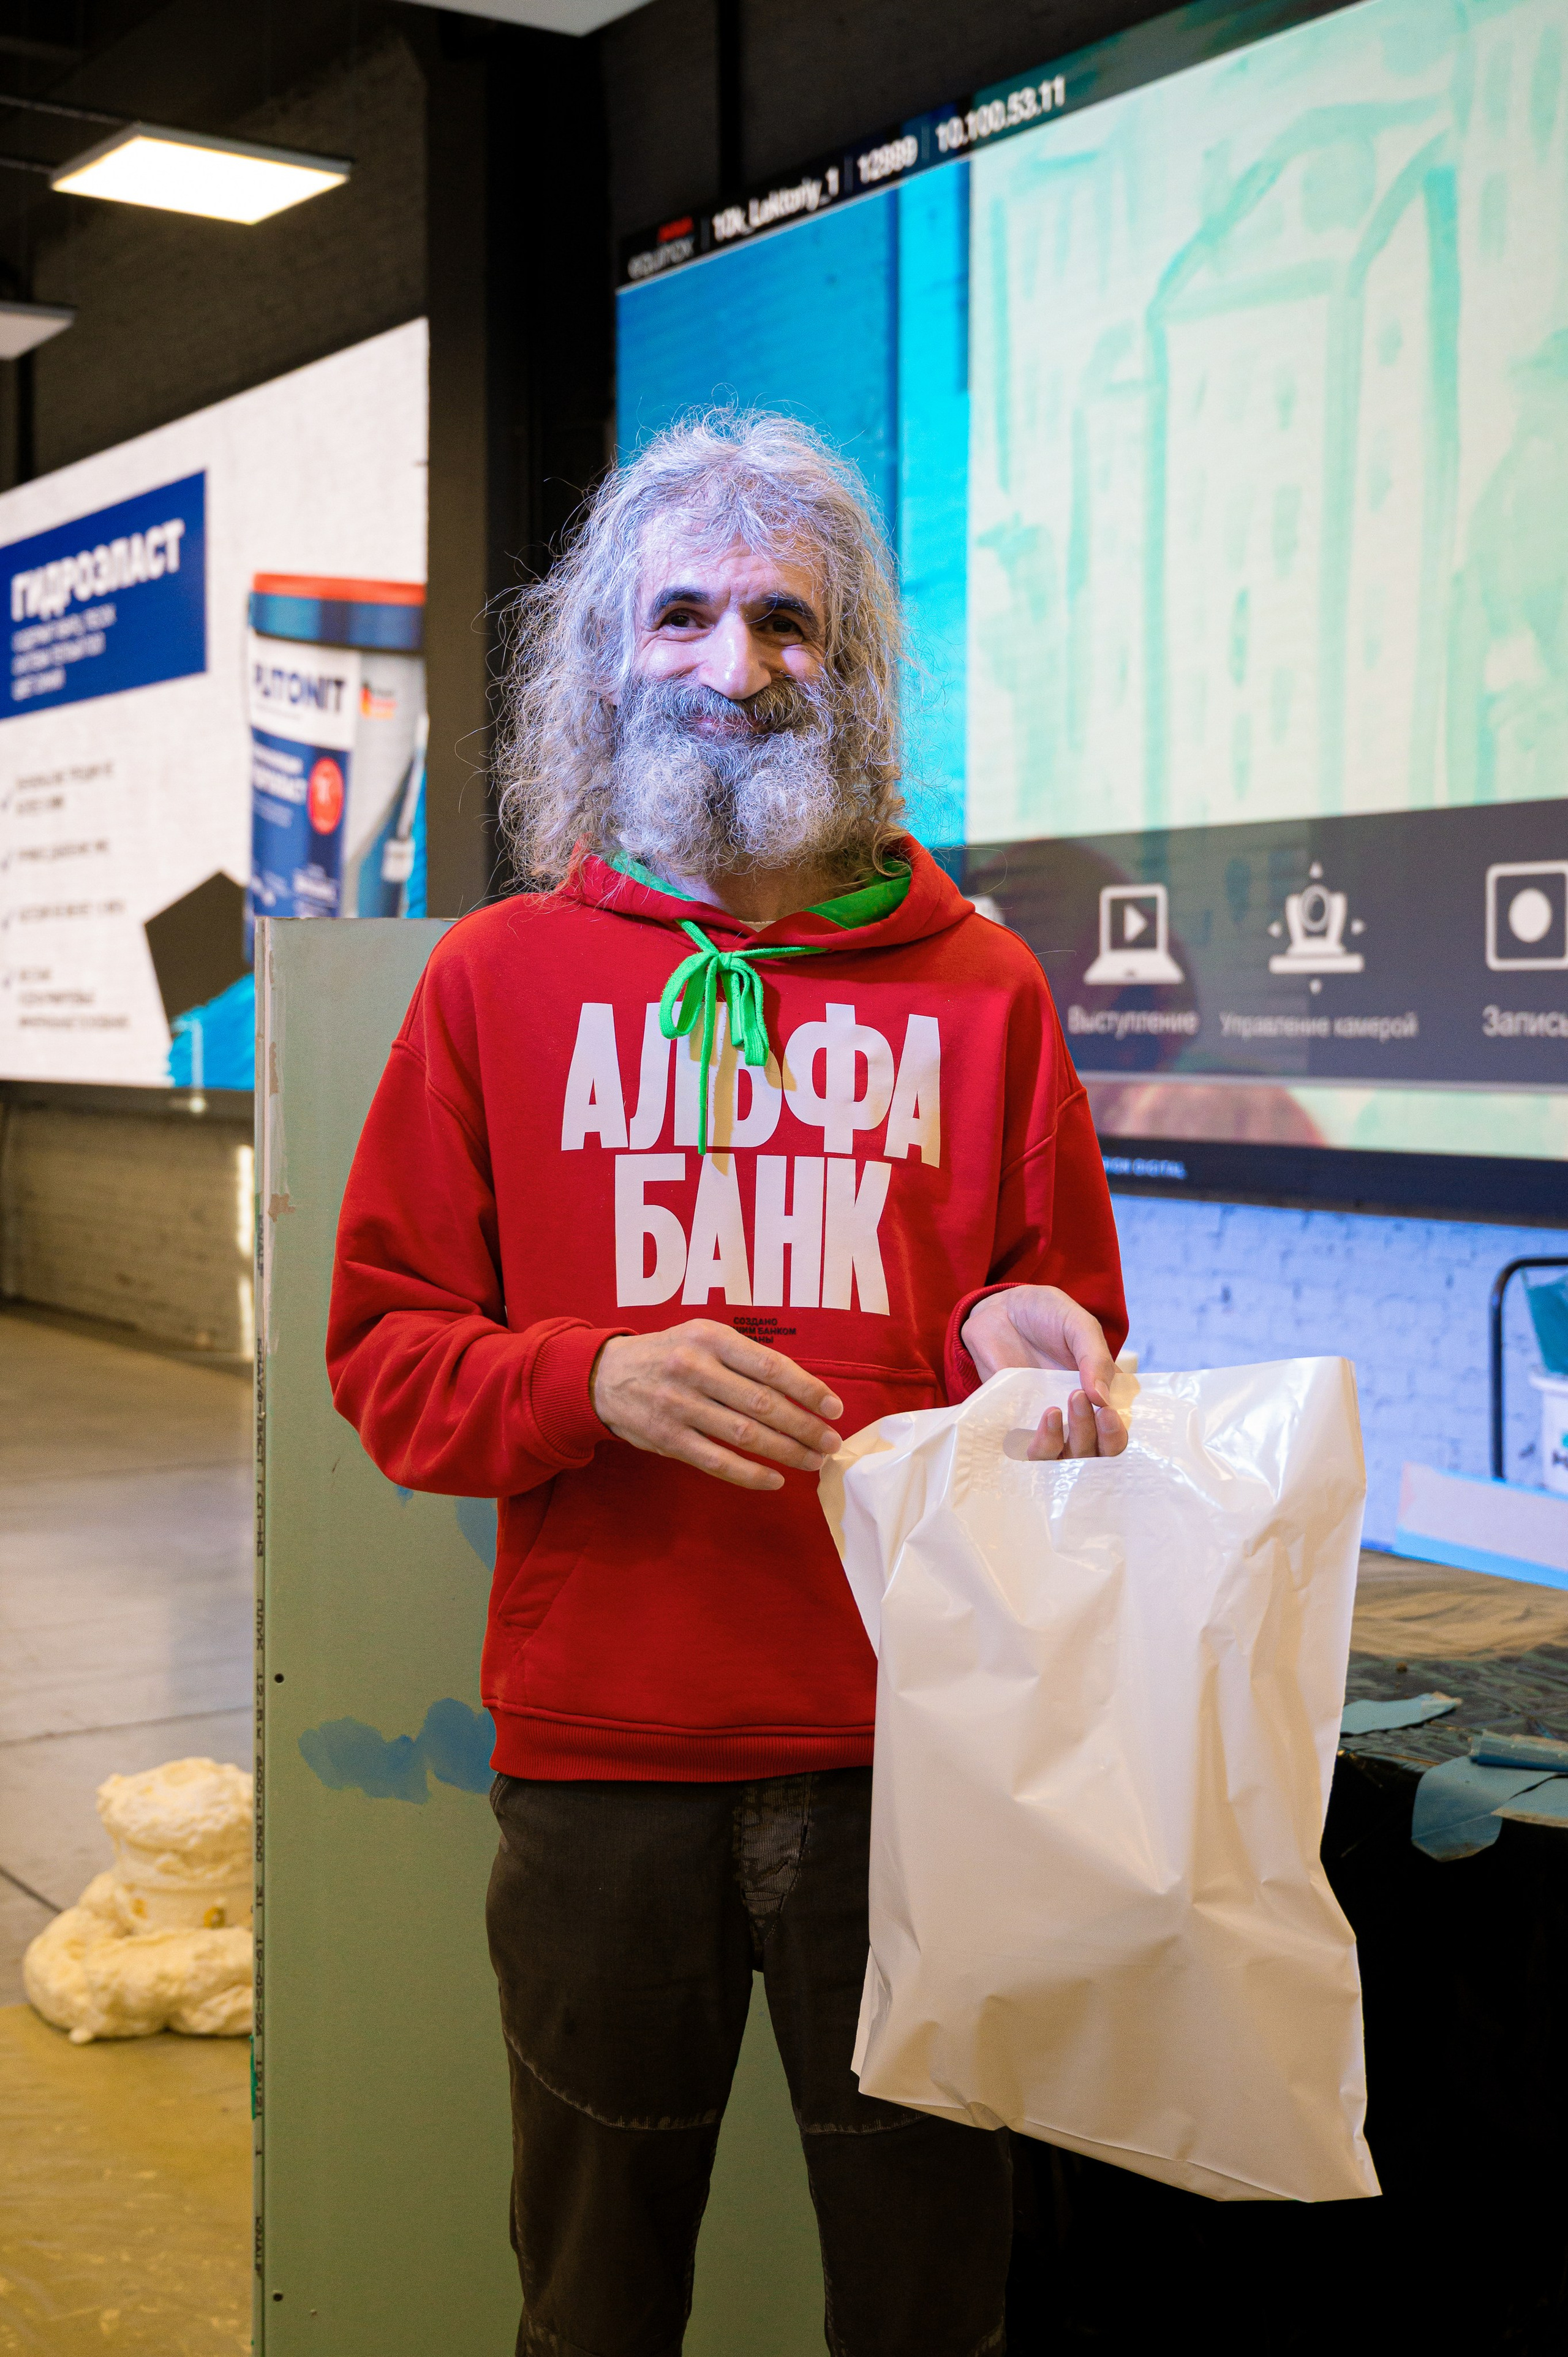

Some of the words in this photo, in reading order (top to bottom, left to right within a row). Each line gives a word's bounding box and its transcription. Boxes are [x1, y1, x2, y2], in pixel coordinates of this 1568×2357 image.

[936, 76, 1065, 152] 10.100.53.11
[1068, 1005, 1199, 1040] Выступление
[1219, 1011, 1330, 1040] Управление
[1334, 1011, 1419, 1043] камерой
[561, 1001, 941, 1169] АЛЬФА
[614, 1152, 892, 1316] БАНК
[733, 1317, 778, 1326] СОЗДАНО
